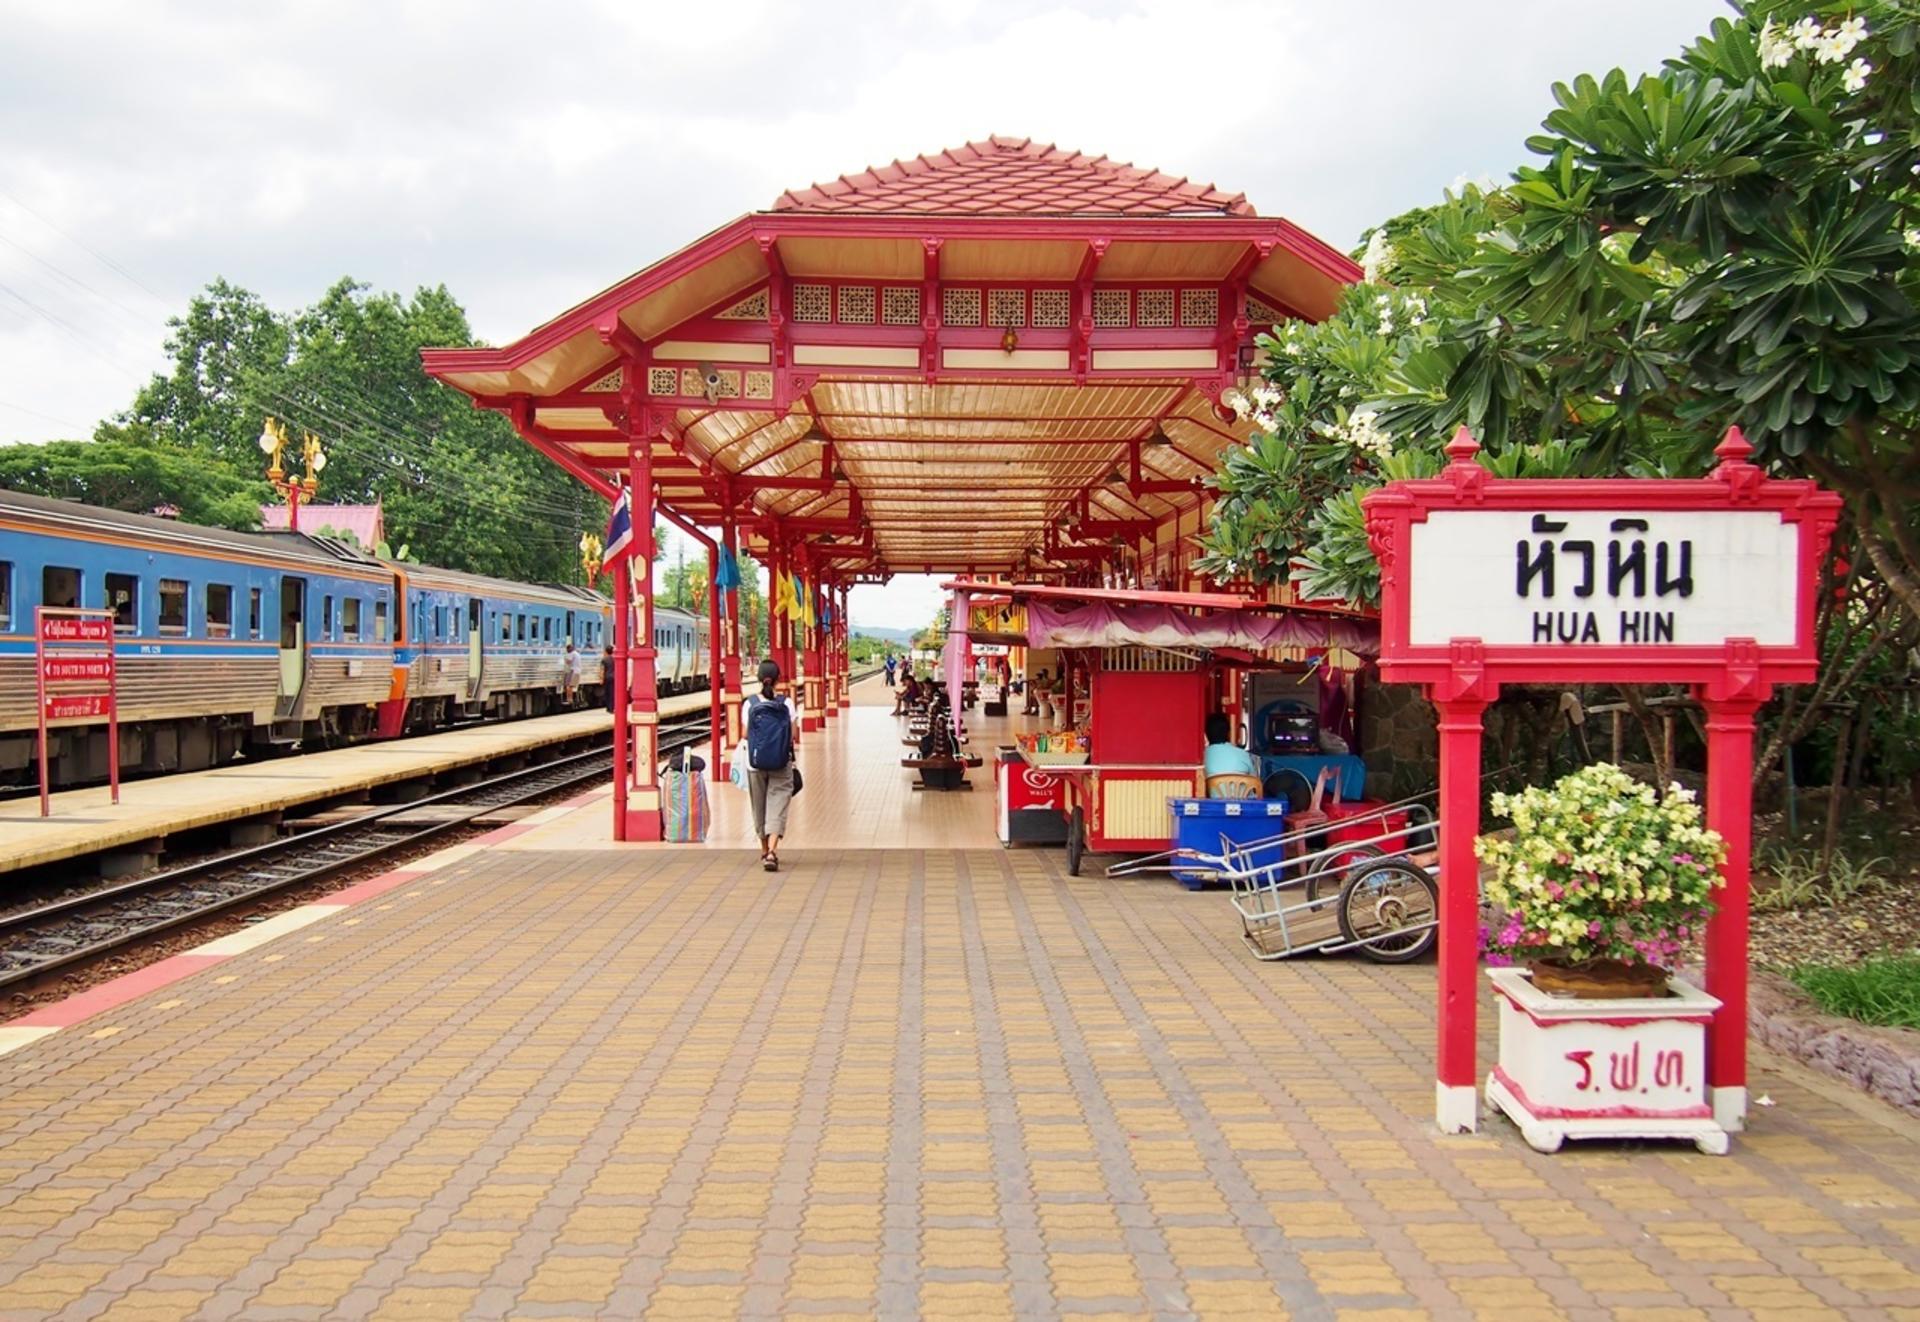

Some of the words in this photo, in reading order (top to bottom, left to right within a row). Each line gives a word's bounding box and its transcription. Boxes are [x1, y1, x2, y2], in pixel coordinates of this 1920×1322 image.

[1516, 513, 1693, 598] หัวหิน
[1533, 611, 1600, 643] HUA
[1620, 611, 1674, 643] HIN
[61, 664, 78, 675] SOUTH
[86, 664, 104, 675] NORTH
[93, 699, 101, 714] 2
